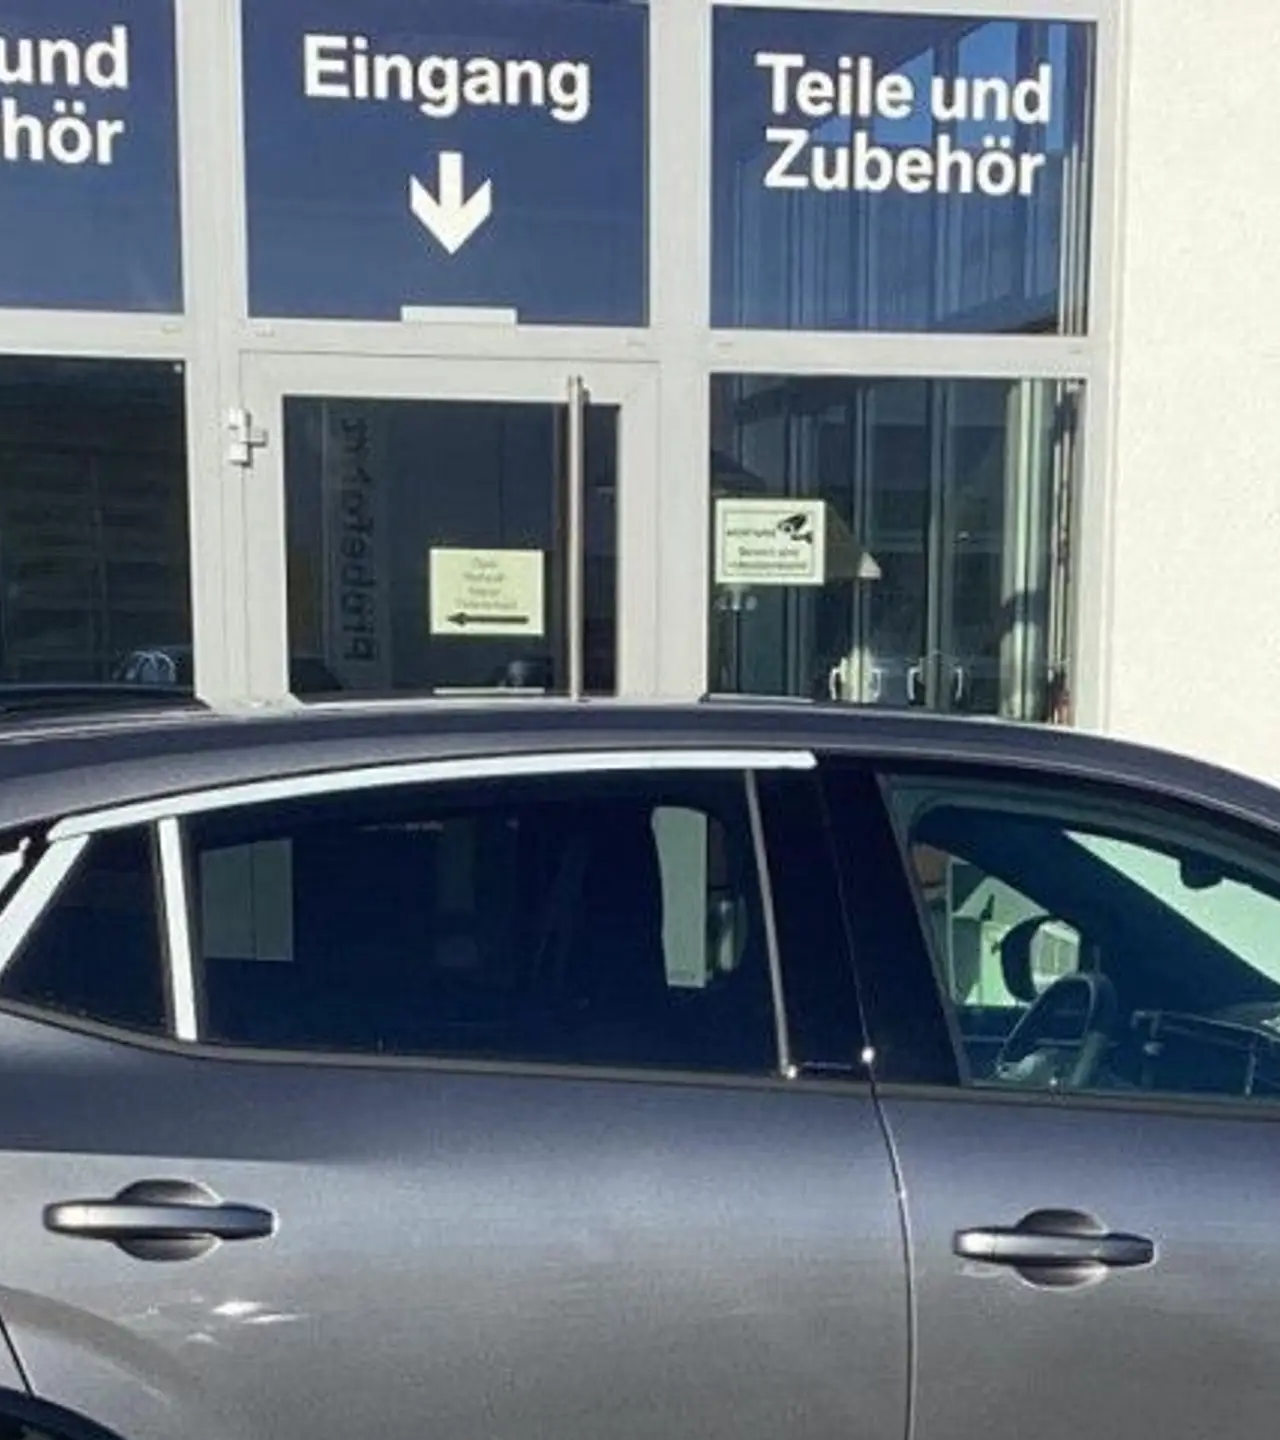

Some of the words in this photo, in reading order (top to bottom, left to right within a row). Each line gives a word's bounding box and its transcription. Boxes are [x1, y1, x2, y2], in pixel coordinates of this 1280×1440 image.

[304, 34, 591, 122] Eingang
[756, 52, 914, 119] Teile
[931, 63, 1052, 124] und
[764, 127, 1046, 196] Zubehör
